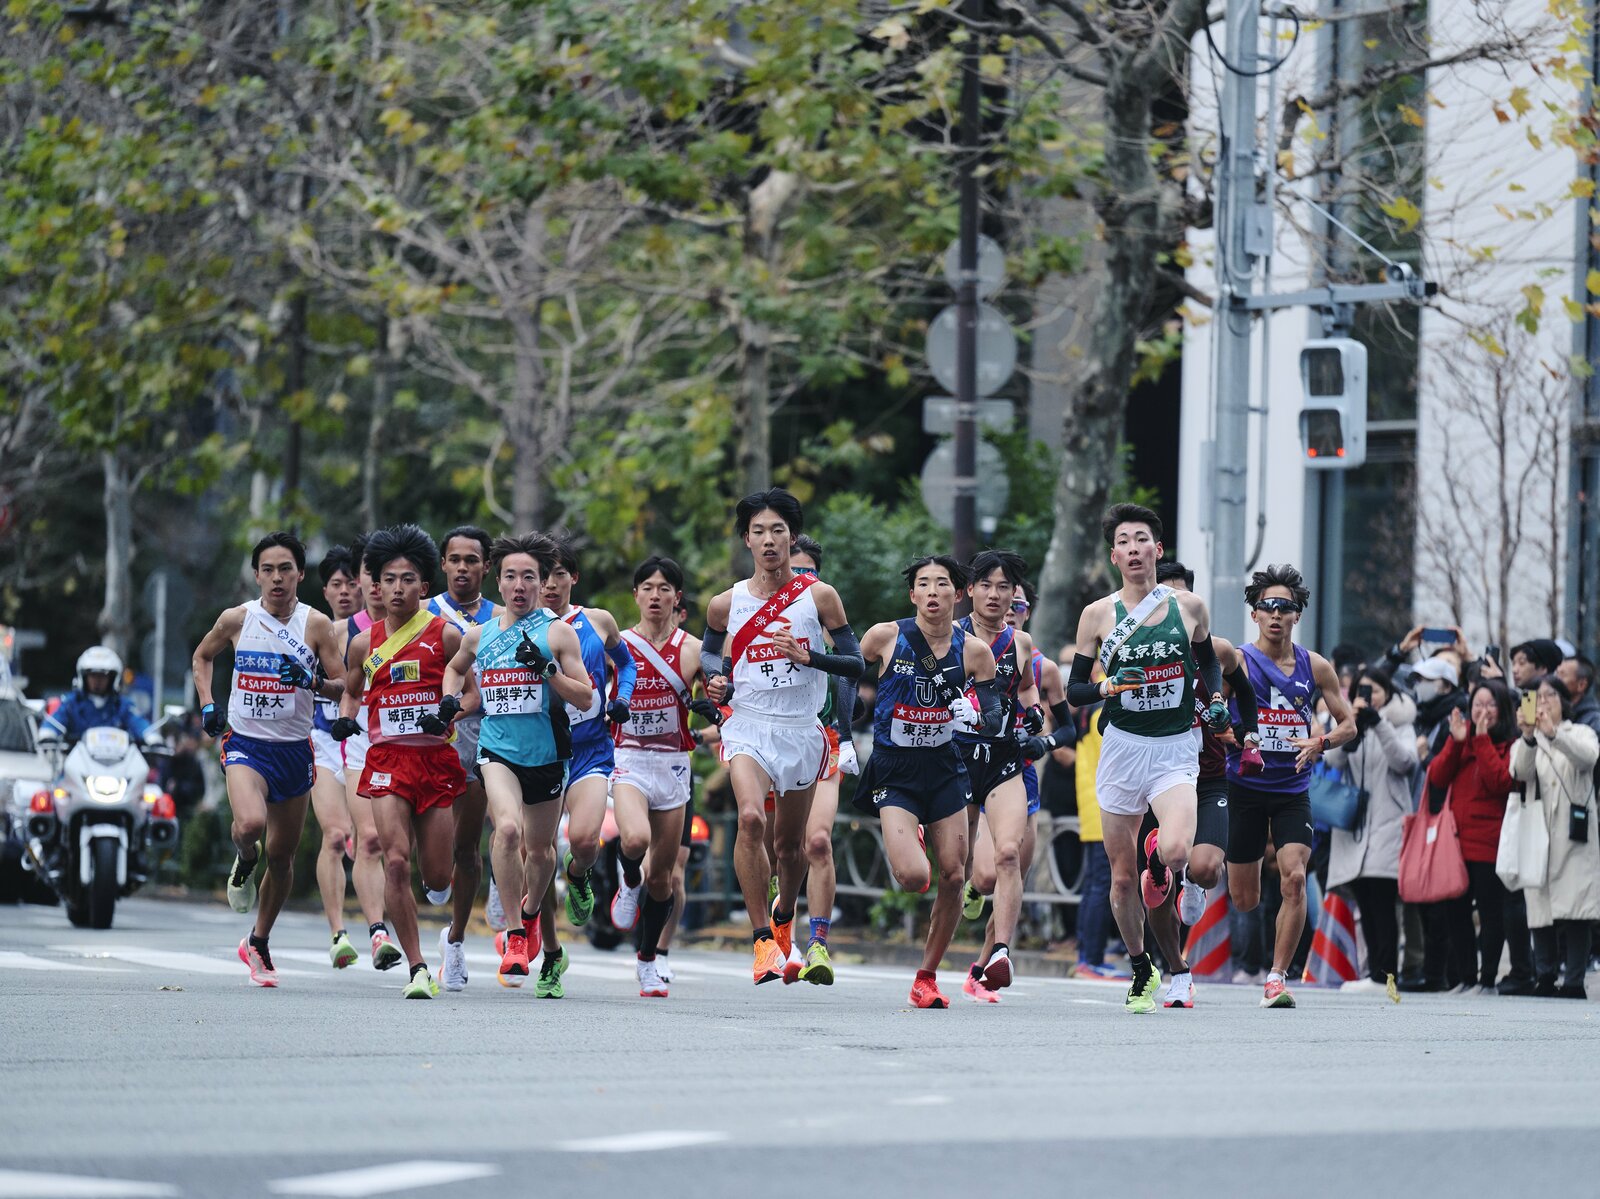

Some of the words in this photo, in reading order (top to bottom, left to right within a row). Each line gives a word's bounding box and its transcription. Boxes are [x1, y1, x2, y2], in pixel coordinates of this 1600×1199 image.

[1118, 641, 1183, 663] 東京農大
[760, 662, 774, 677] 中
[1143, 665, 1181, 681] APPORO
[493, 671, 540, 684] SAPPORO
[771, 676, 793, 688] 2-1
[243, 692, 285, 709] 日体大
[389, 691, 436, 705] SAPPORO
[485, 686, 537, 703] 山梨学大
[496, 702, 523, 714] 23-1
[630, 695, 675, 709] SAPPORO
[1138, 699, 1171, 711] 21-11
[250, 707, 277, 719] 14-1
[908, 709, 950, 721] SAPPOR
[1268, 712, 1305, 723] SAPPOR
[633, 725, 664, 735] 13-12
[902, 722, 946, 738] 東洋大
[1265, 725, 1279, 739] 立
[910, 737, 937, 747] 10-1
